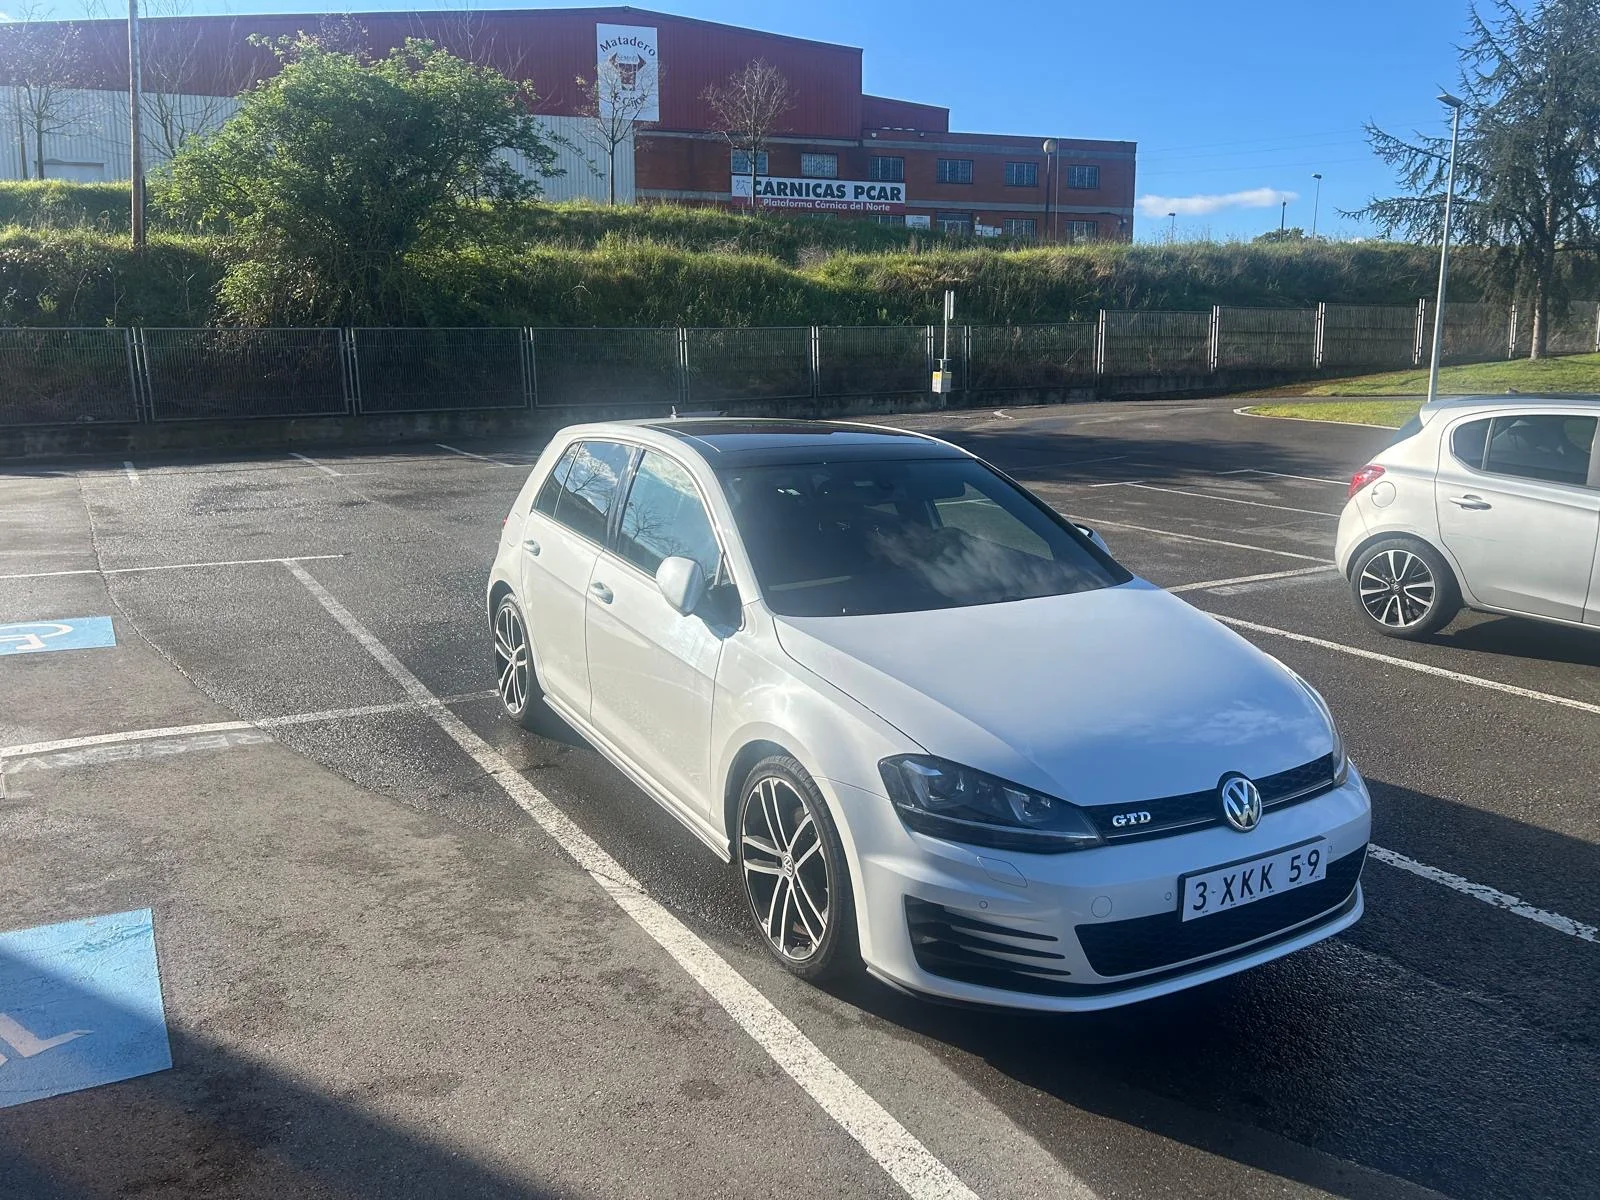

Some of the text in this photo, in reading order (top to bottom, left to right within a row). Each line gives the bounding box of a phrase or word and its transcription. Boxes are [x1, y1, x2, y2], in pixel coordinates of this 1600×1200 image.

[599, 35, 656, 57] Matadero
[753, 177, 902, 202] CÁRNICAS PCAR
[763, 198, 891, 212] Plataforma Cárnica del Norte
[1112, 810, 1152, 828] GTD
[1192, 849, 1320, 911] 3 XKK 59
